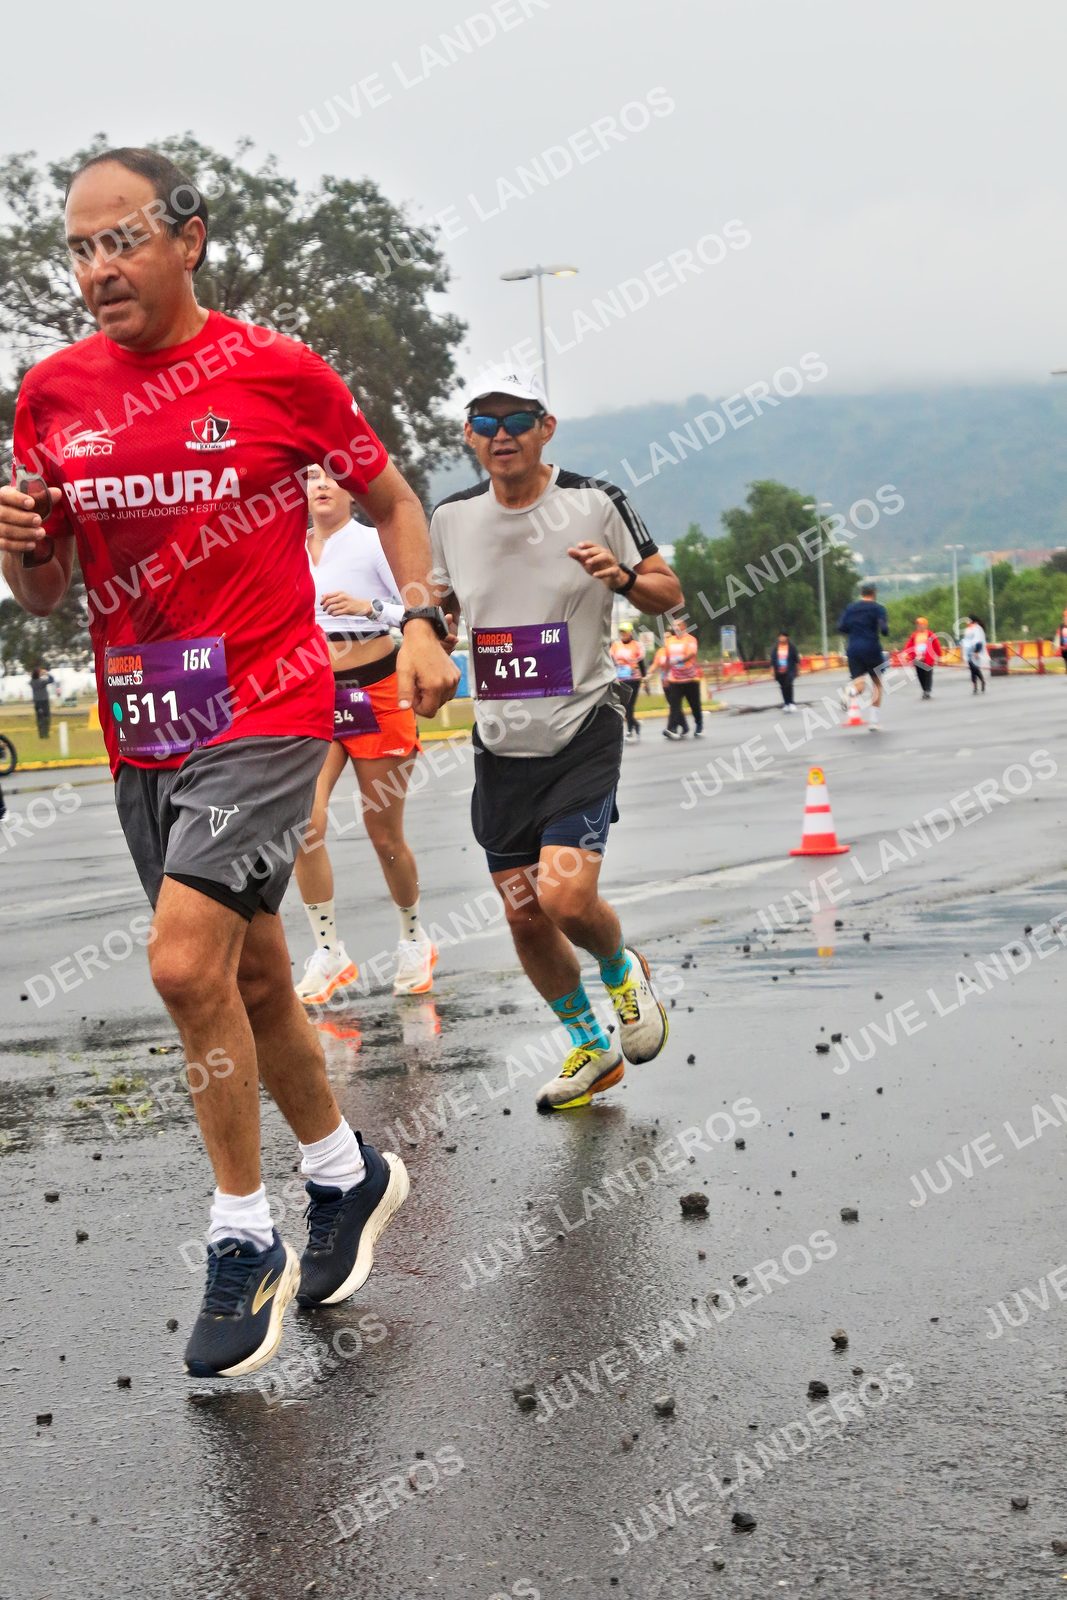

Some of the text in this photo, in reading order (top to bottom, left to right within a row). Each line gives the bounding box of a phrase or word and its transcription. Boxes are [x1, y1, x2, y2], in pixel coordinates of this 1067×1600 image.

[63, 467, 241, 513] PERDURA
[117, 505, 189, 520] JUNTEADORES
[196, 501, 241, 513] ESTUCOS
[476, 633, 513, 646] CARRERA
[540, 628, 561, 645] 15K
[108, 654, 143, 674] CARRERA
[182, 647, 212, 671] 15K
[494, 656, 539, 679] 412
[349, 691, 365, 703] 15K
[126, 690, 179, 725] 511
